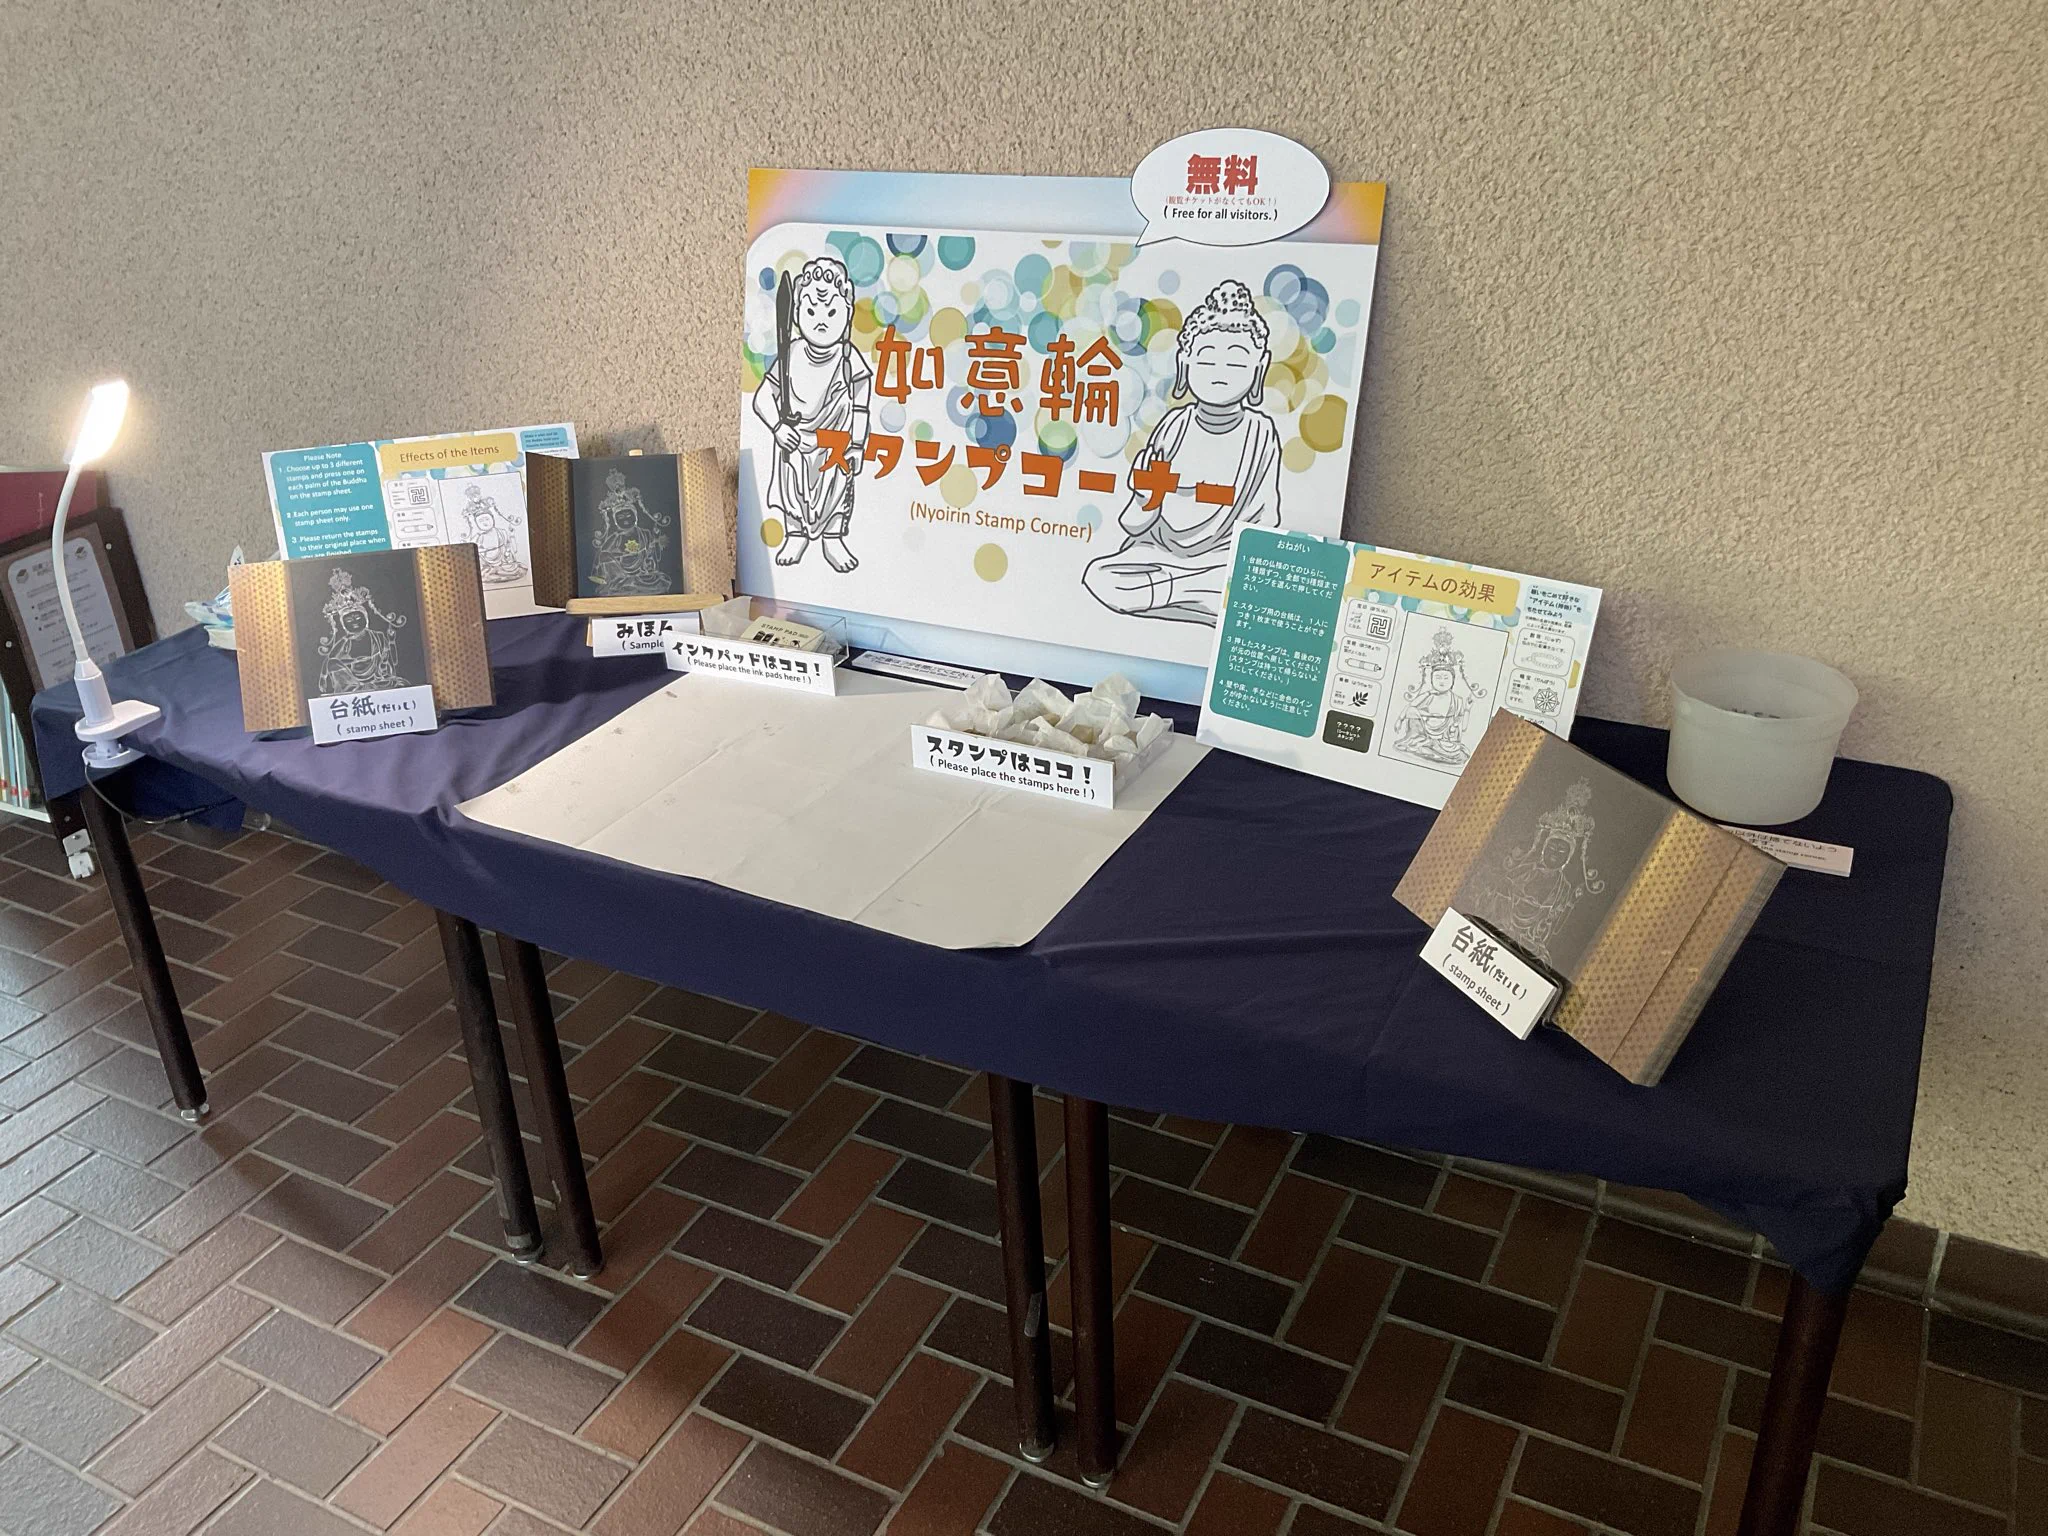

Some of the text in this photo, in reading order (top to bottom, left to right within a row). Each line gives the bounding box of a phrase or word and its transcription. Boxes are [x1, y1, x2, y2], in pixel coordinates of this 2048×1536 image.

[1185, 153, 1259, 195] 無料
[1172, 207, 1194, 219] Free
[1197, 208, 1212, 219] for
[1215, 208, 1228, 219] all
[875, 324, 1124, 427] 如意輪
[303, 452, 342, 462] Please Note
[399, 443, 500, 464] Effects of the Items
[286, 465, 311, 473] Choose
[311, 463, 321, 471] up
[335, 459, 364, 468] different
[815, 428, 1237, 512] スタンプコーナー
[286, 473, 310, 482] stamps
[310, 472, 323, 480] and
[324, 471, 342, 480] press
[287, 483, 304, 491] each
[304, 480, 321, 490] palm
[342, 477, 368, 485] Buddha
[299, 491, 311, 499] the
[311, 489, 332, 498] stamp
[293, 509, 310, 518] Each
[310, 507, 333, 516] person
[333, 506, 348, 515] may
[348, 504, 360, 512] use
[361, 503, 374, 511] one
[294, 518, 315, 527] stamp
[315, 516, 335, 525] sheet
[910, 500, 1093, 543] (Nyoirin Stamp Corner)
[299, 534, 321, 543] Please
[321, 532, 343, 541] return
[343, 530, 355, 538] the
[355, 528, 378, 537] stamps
[307, 543, 323, 551] their
[324, 540, 349, 550] original
[349, 538, 367, 548] place
[367, 536, 386, 545] when
[1276, 539, 1311, 553] おねがい
[1242, 583, 1259, 593] さい。
[1370, 563, 1495, 603] アイテムの効果
[761, 623, 784, 632] STAMP
[1235, 620, 1253, 631] ます。
[693, 658, 717, 669] Please
[718, 661, 738, 672] place
[738, 665, 751, 674] the
[752, 667, 763, 677] ink
[765, 670, 783, 680] pads
[784, 673, 801, 683] here
[1221, 698, 1251, 712] ください。
[346, 723, 377, 735] stamp
[379, 719, 406, 730] sheet
[938, 758, 969, 773] Please
[971, 765, 997, 780] place
[999, 771, 1016, 783] the
[1018, 775, 1054, 792] stamps
[1056, 783, 1080, 797] here
[1448, 963, 1476, 990] stamp
[1475, 986, 1502, 1011] sheet
